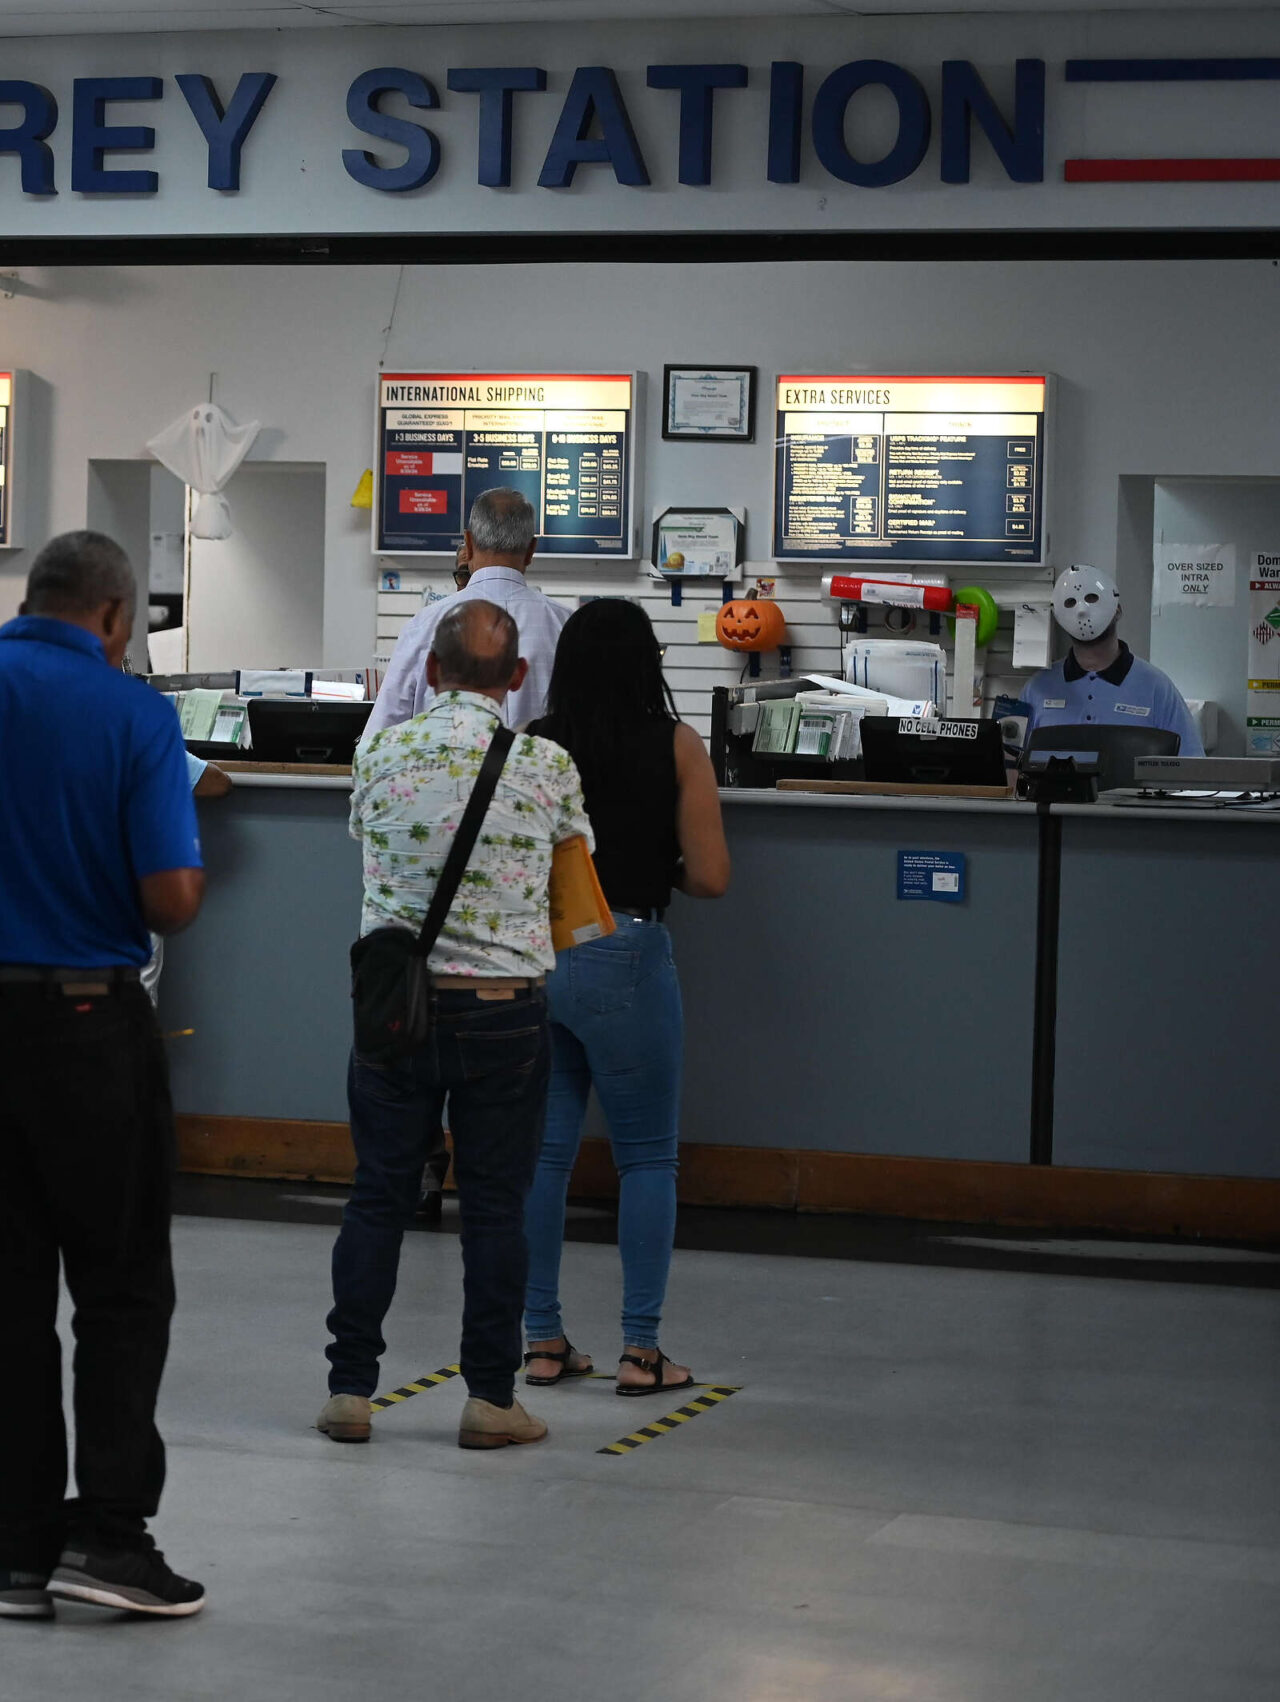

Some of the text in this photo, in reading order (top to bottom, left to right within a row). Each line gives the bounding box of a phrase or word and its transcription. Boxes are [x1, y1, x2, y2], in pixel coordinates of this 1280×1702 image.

[341, 58, 1046, 193] STATION
[386, 386, 545, 402] INTERNATIONAL SHIPPING
[785, 389, 891, 404] EXTRA SERVICES
[395, 433, 454, 442] 1-3 BUSINESS DAYS
[1167, 563, 1224, 571] OVER SIZED
[1182, 584, 1209, 593] ONLY
[900, 719, 977, 738] NO CELL PHONES
